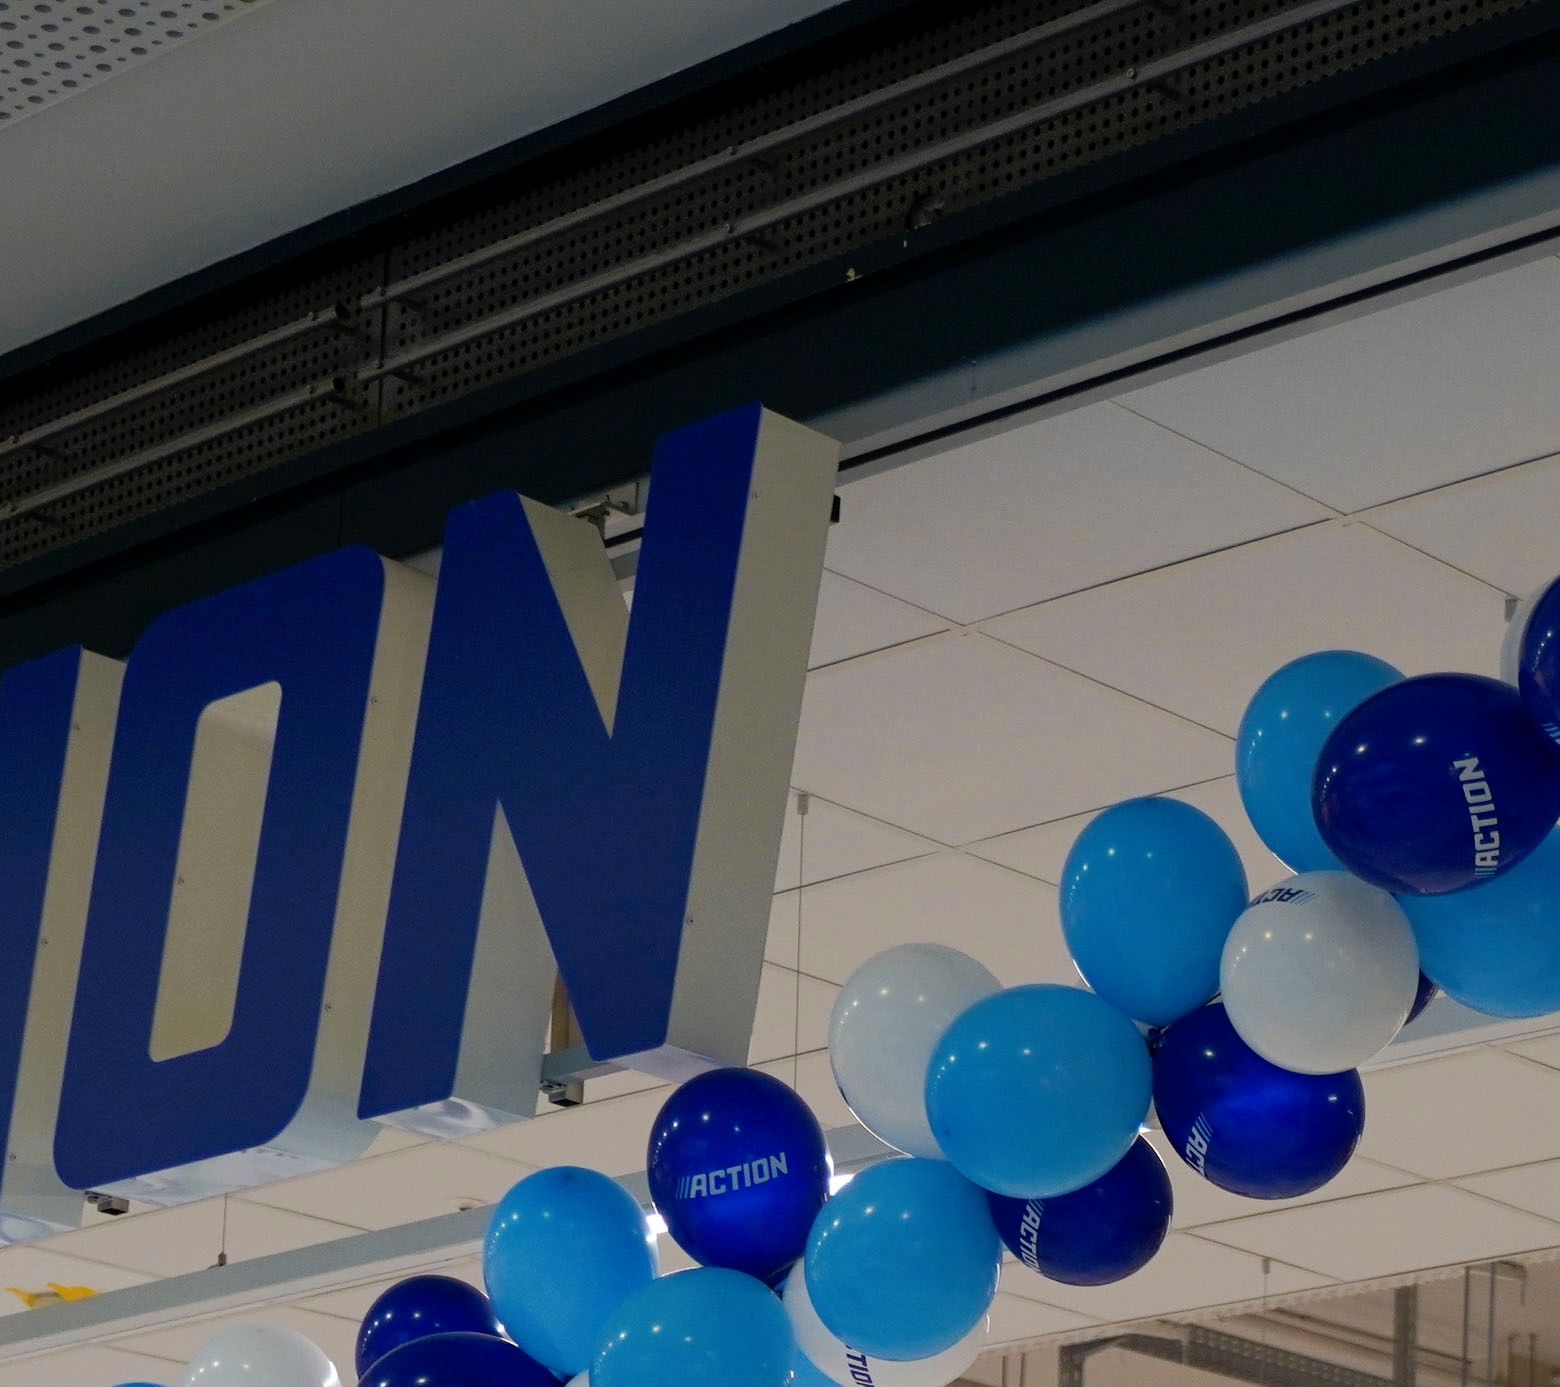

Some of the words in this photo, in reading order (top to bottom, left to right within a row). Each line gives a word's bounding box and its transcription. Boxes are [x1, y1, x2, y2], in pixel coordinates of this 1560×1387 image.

[1452, 756, 1500, 867] ACTION
[689, 1151, 789, 1199] ACTION
[1019, 1202, 1042, 1270] ACTIO
